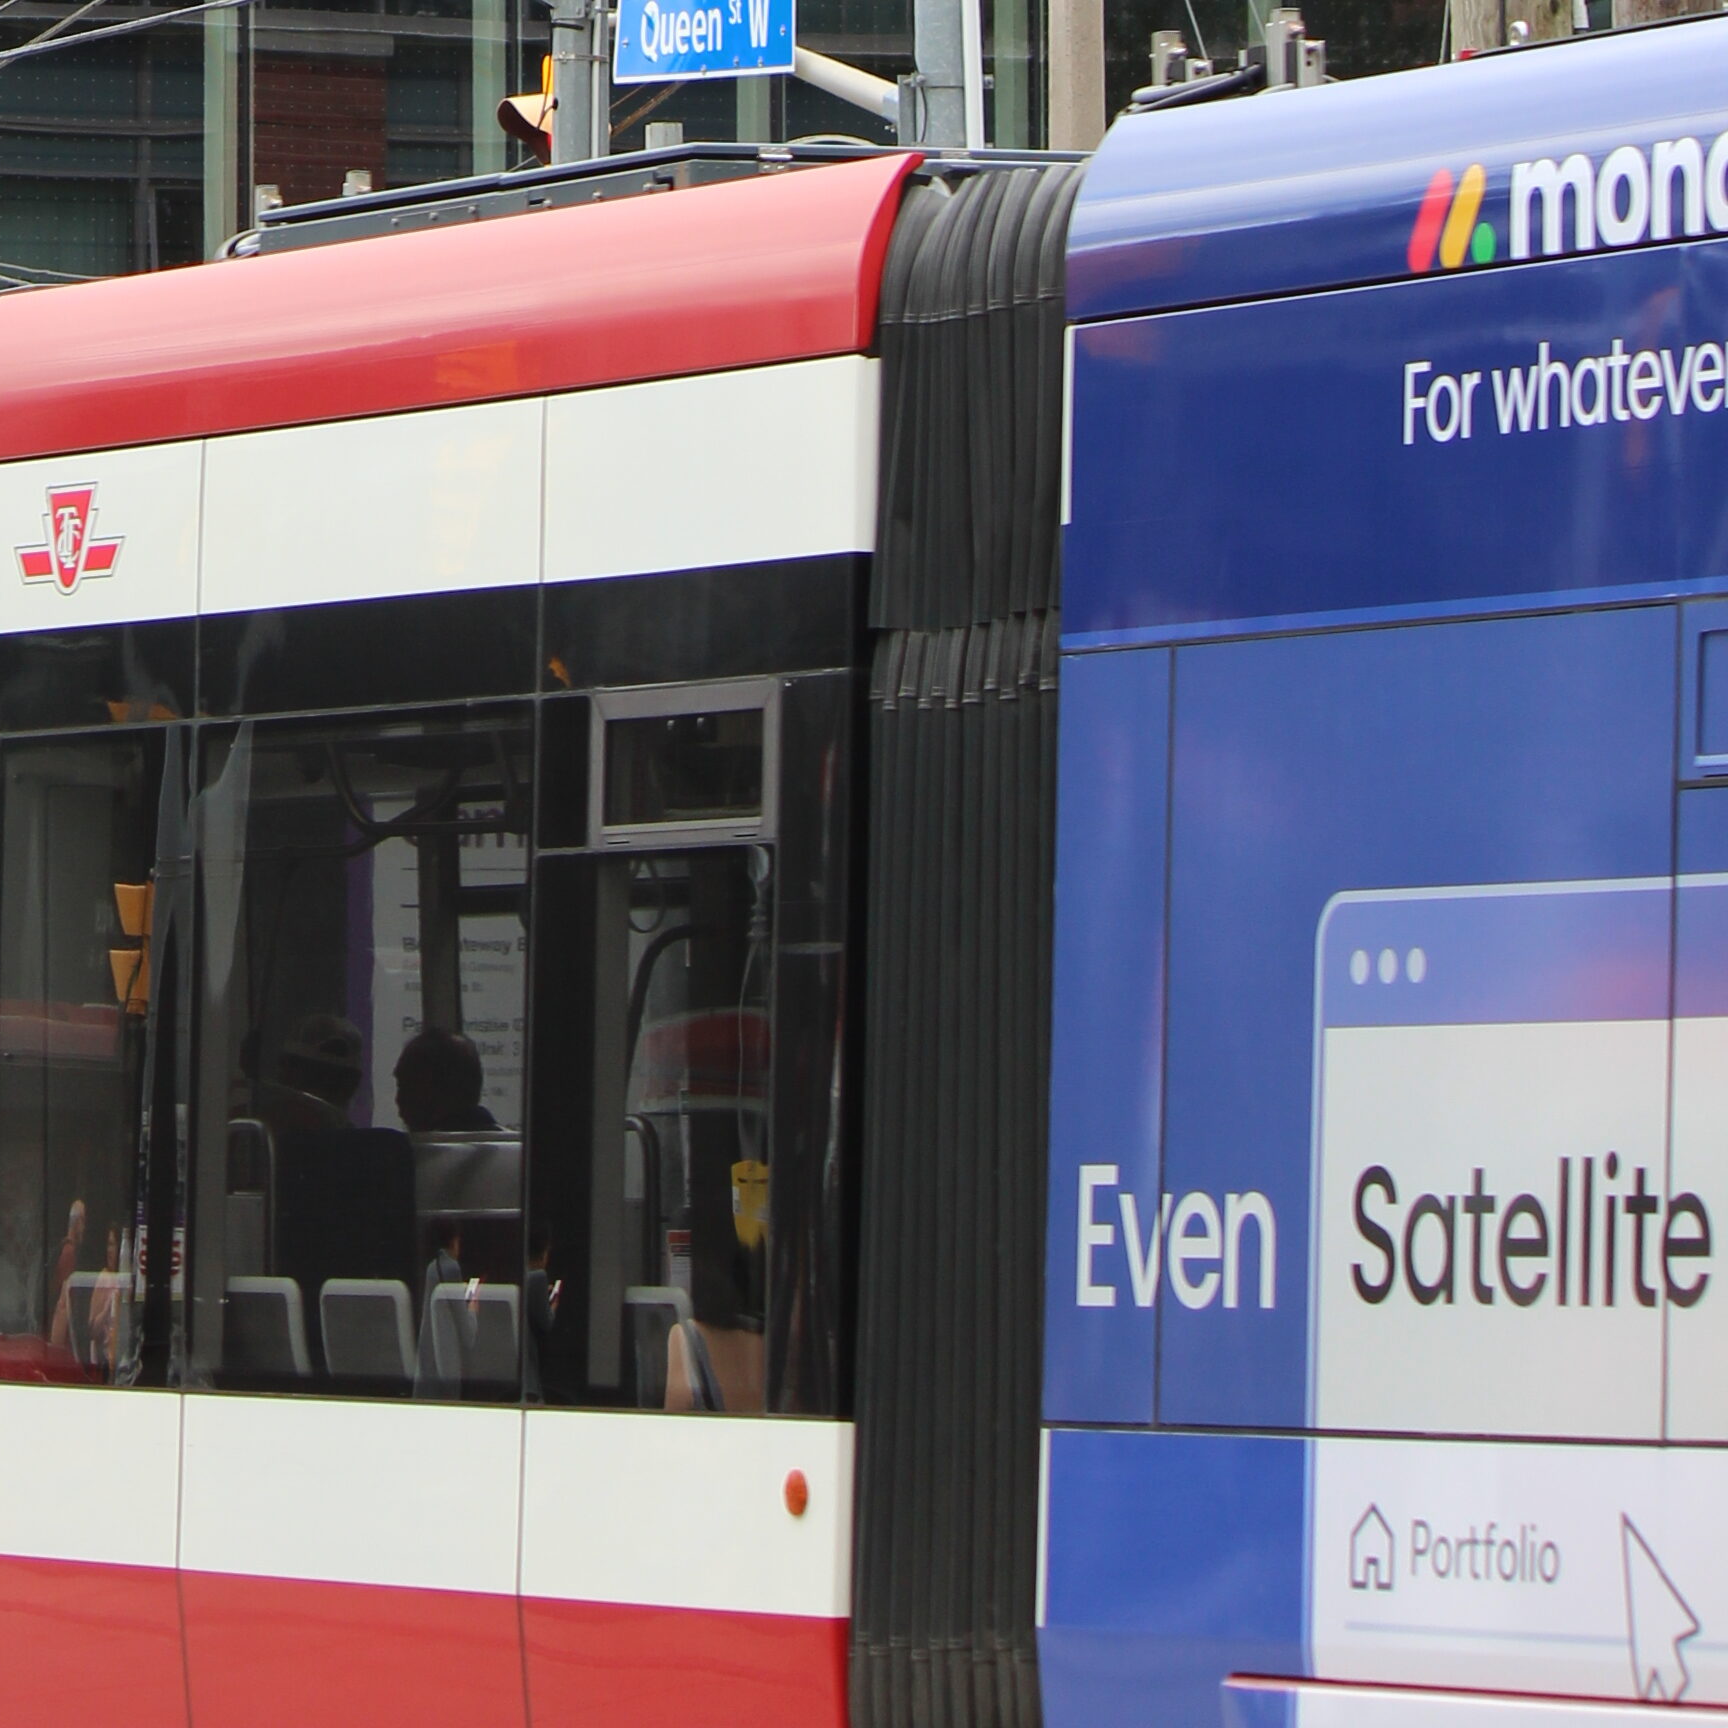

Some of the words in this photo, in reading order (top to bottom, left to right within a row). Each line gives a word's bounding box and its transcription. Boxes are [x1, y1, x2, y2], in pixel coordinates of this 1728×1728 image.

[640, 0, 722, 63] Queen
[1510, 129, 1728, 260] mon
[1403, 360, 1482, 445] For
[1491, 338, 1728, 435] whateve
[1076, 1163, 1276, 1309] Even
[1351, 1151, 1712, 1309] Satellite
[1411, 1519, 1560, 1584] Portfolio
